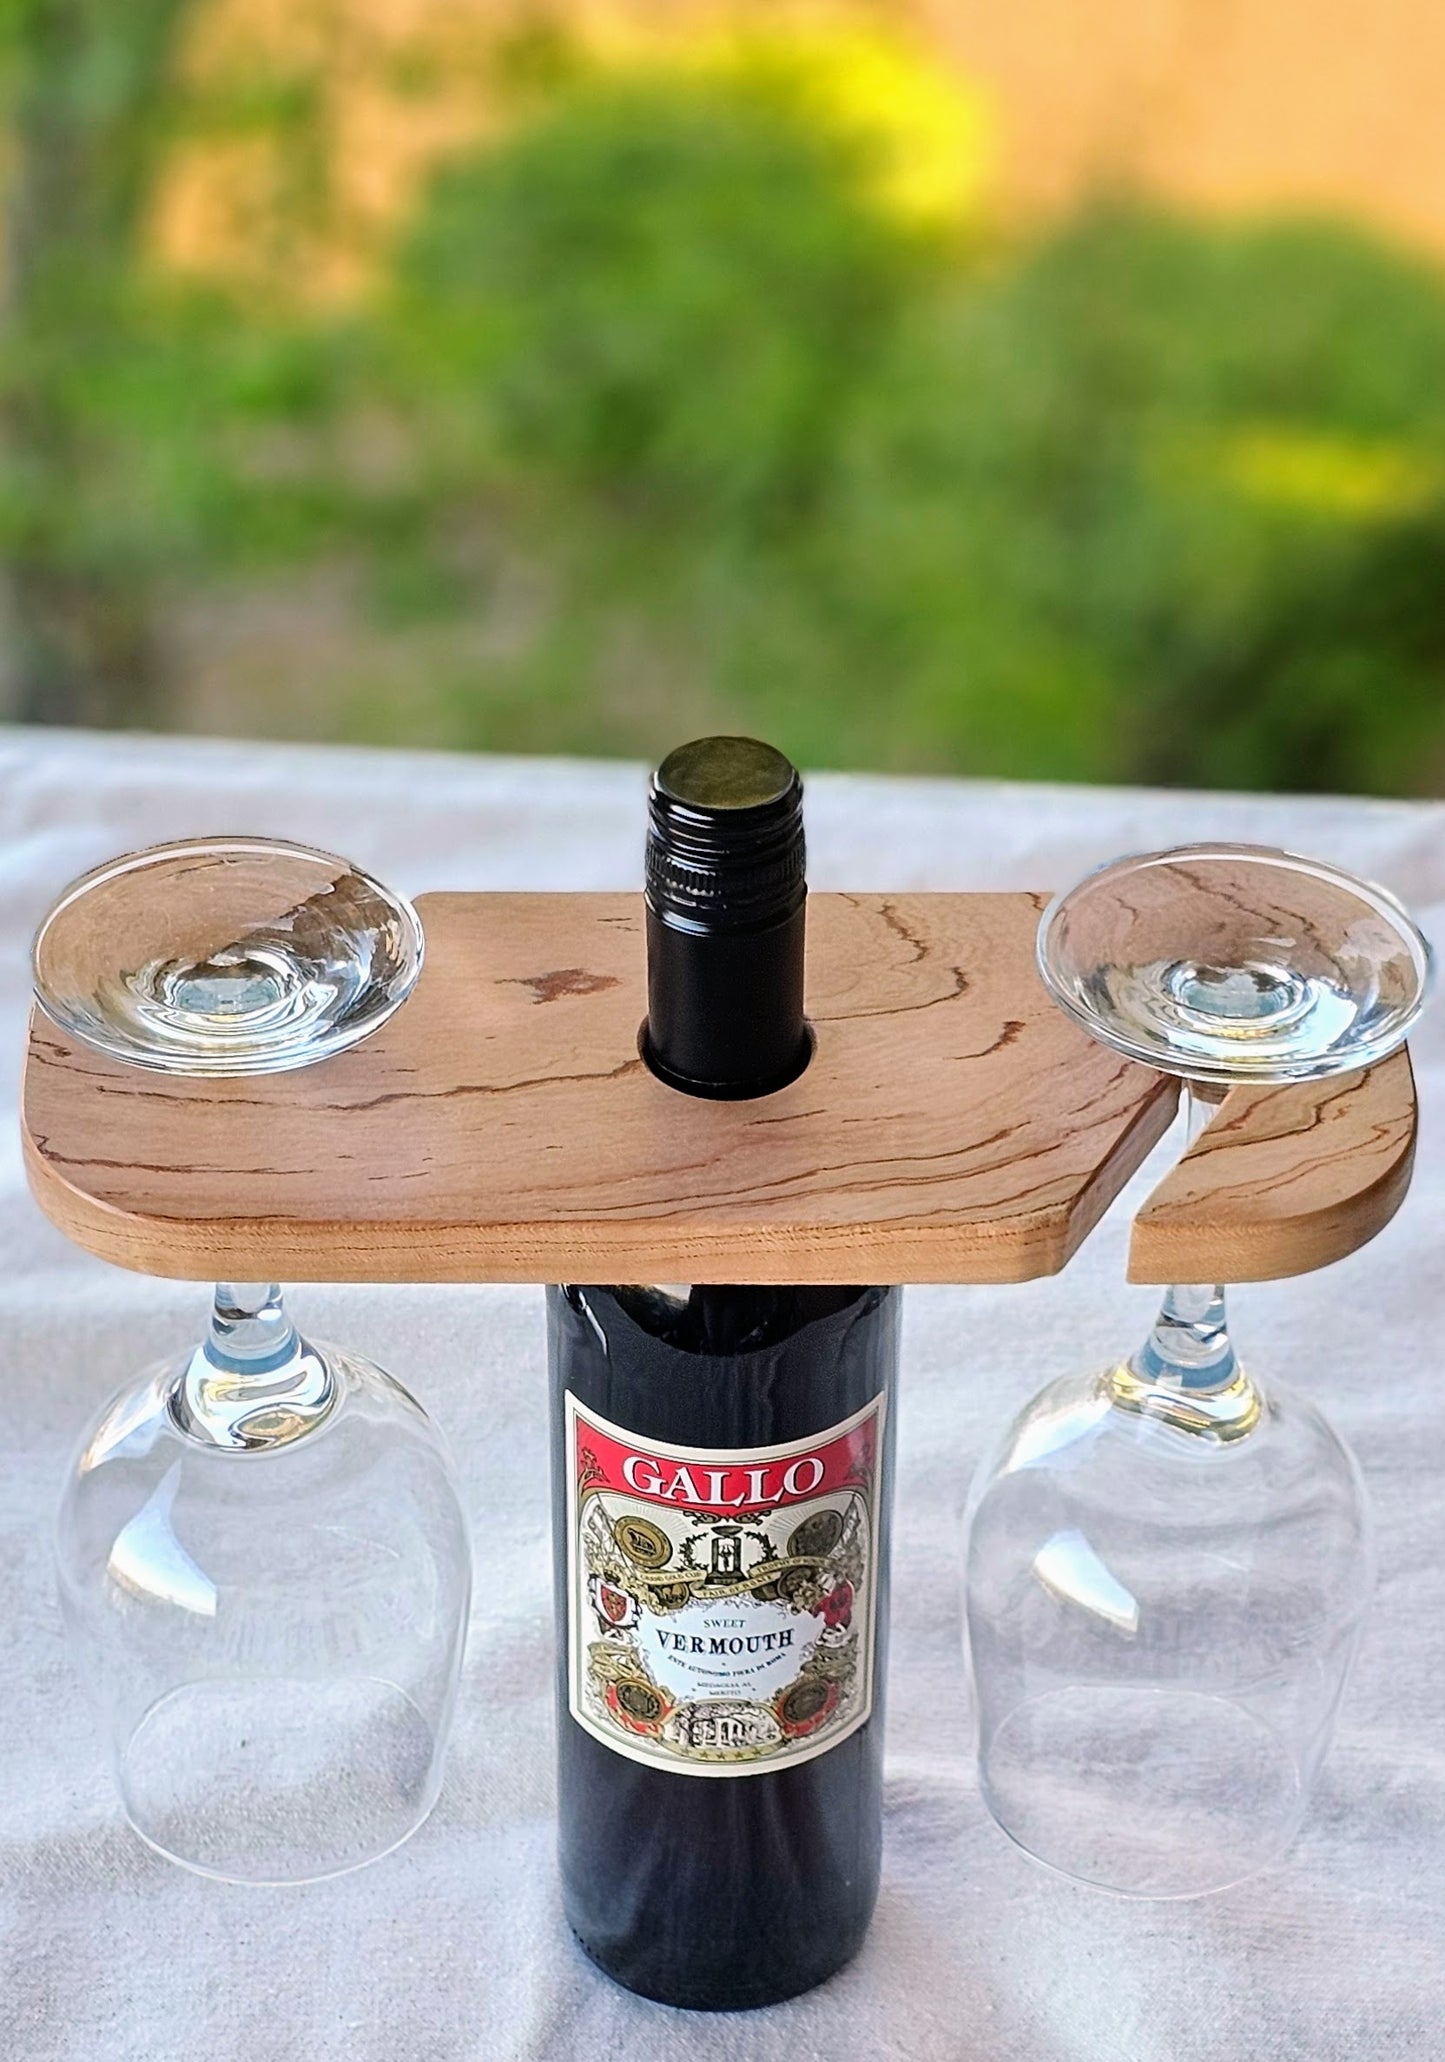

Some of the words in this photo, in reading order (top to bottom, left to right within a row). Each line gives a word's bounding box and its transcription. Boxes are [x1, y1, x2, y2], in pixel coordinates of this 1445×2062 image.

[622, 1455, 825, 1507] GALLO
[703, 1589, 725, 1597] FAIR
[703, 1619, 747, 1629] SWEET
[656, 1627, 795, 1655] VERMOUTH
